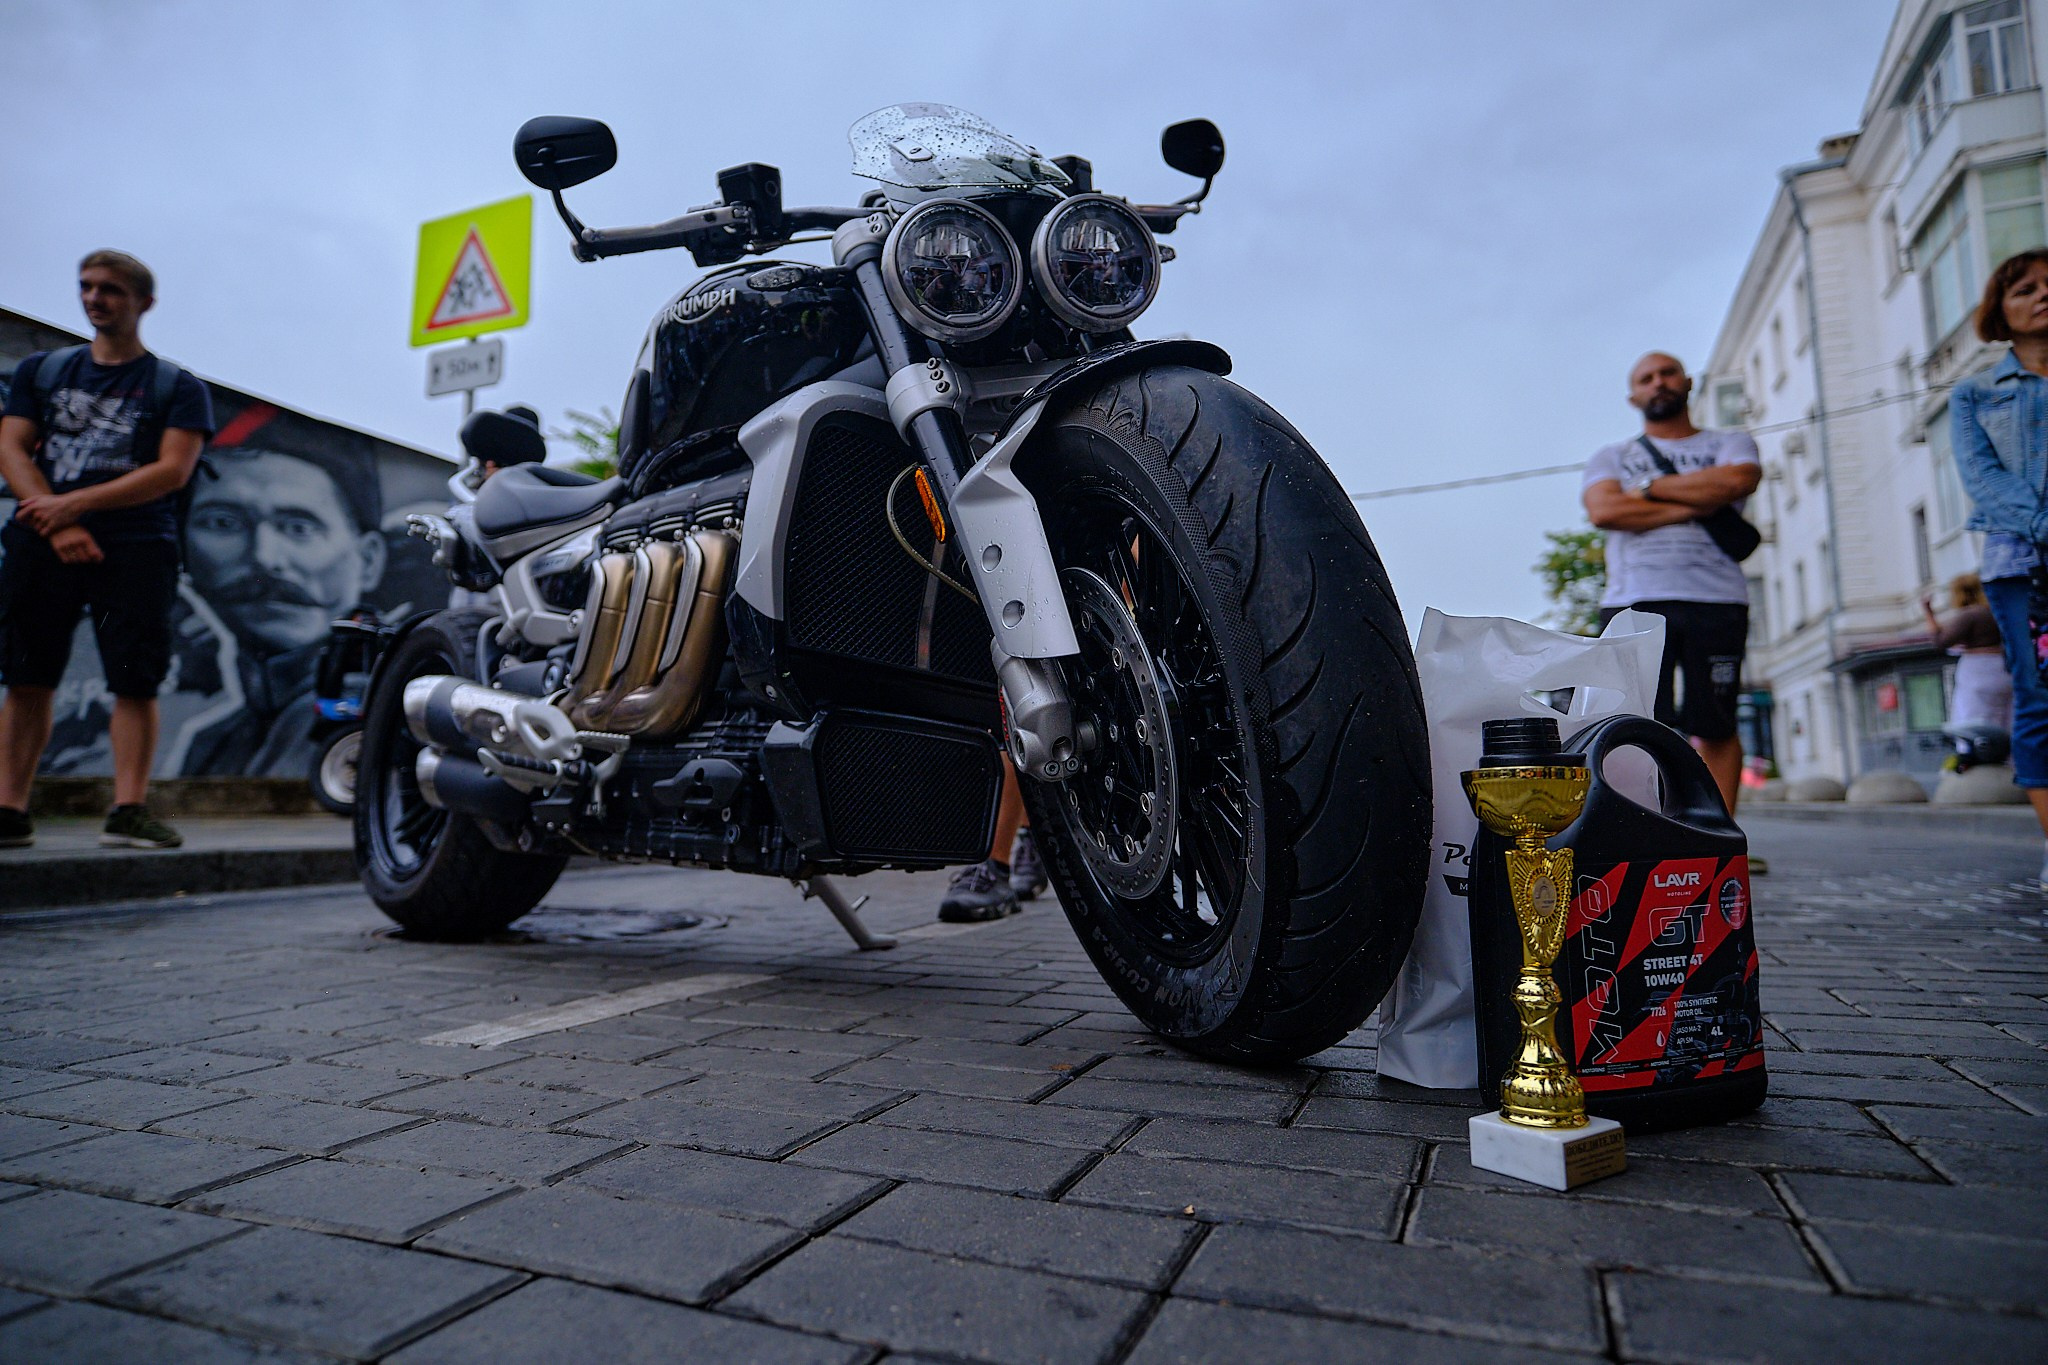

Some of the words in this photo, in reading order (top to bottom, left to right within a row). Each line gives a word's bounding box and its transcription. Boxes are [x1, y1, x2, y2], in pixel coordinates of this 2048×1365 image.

[661, 287, 736, 324] TRIUMPH
[1653, 872, 1700, 888] LAVR
[1649, 904, 1711, 947] GT
[1643, 955, 1687, 970] STREET
[1690, 954, 1703, 965] 4T
[1644, 972, 1685, 987] 10W40
[1673, 1000, 1688, 1009] 100%
[1689, 997, 1718, 1007] SYNTHETIC
[1651, 1006, 1667, 1017] 7726
[1674, 1010, 1694, 1018] MOTOR
[1676, 1026, 1688, 1034] JASO
[1711, 1026, 1723, 1036] 4L
